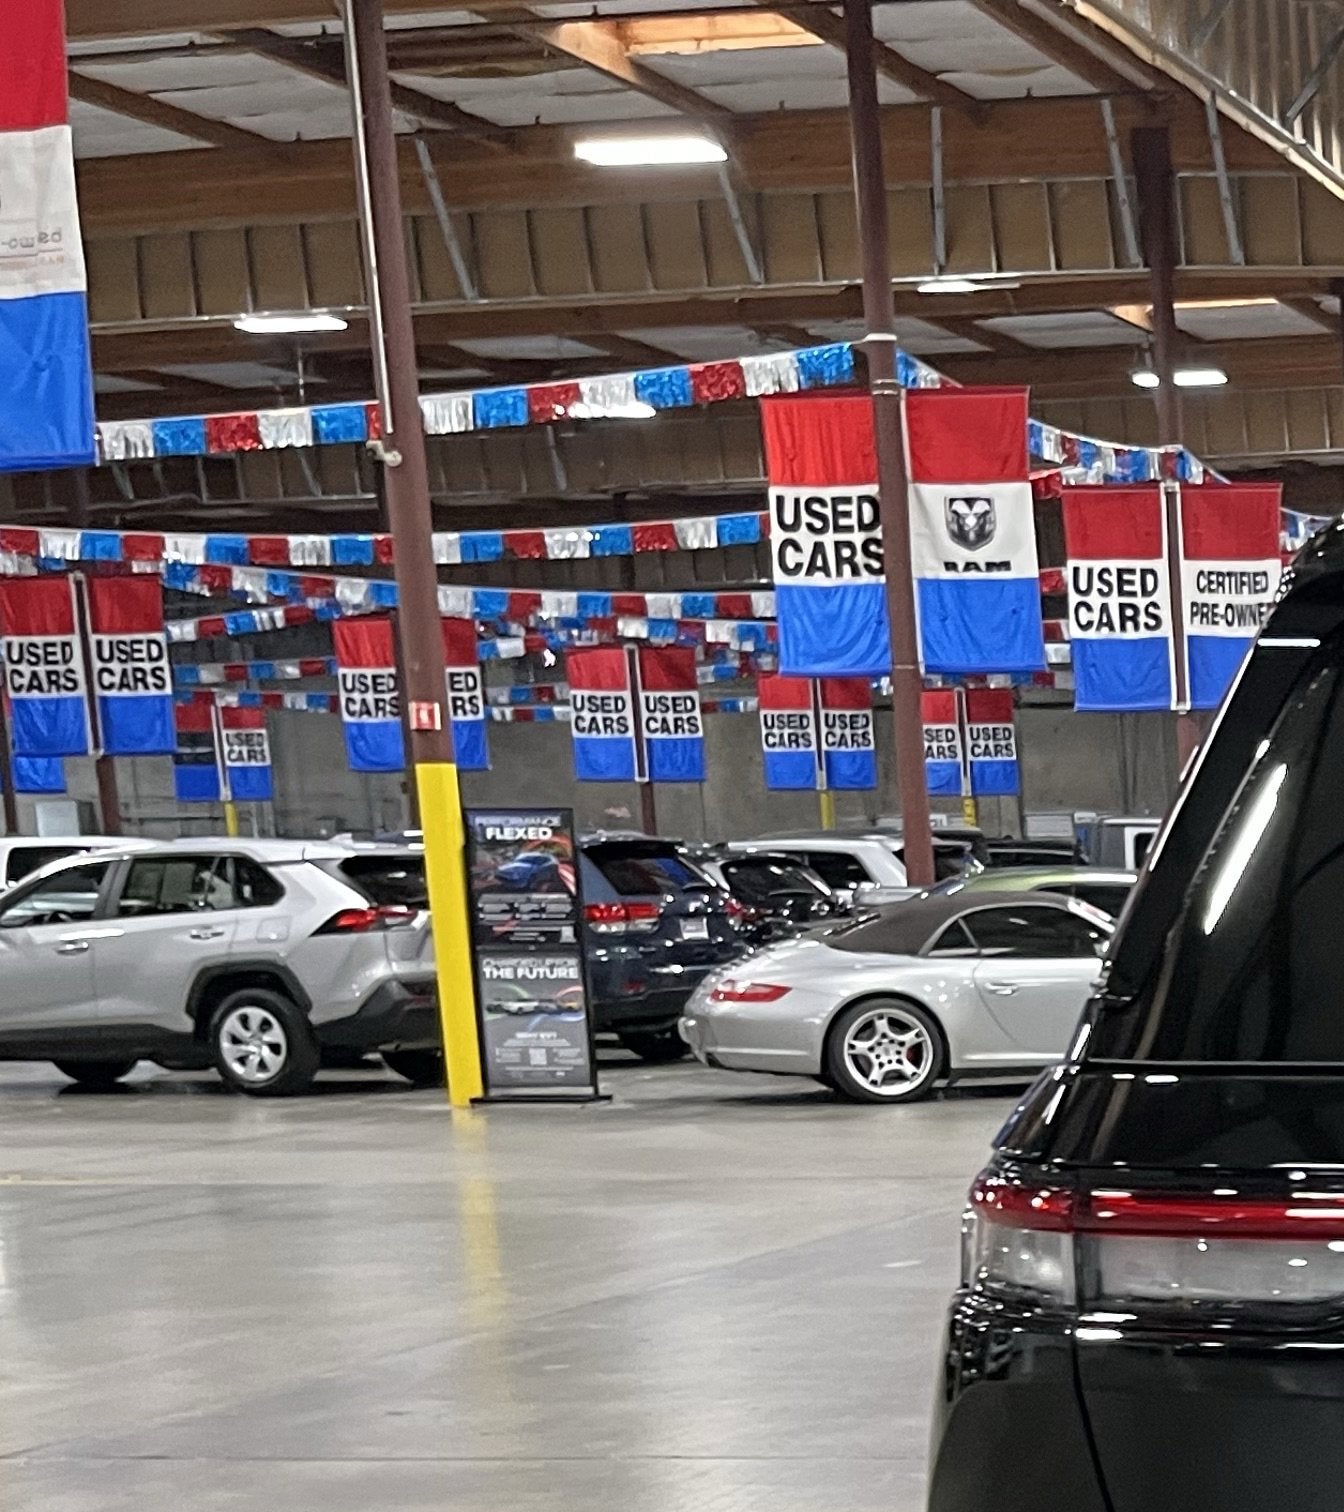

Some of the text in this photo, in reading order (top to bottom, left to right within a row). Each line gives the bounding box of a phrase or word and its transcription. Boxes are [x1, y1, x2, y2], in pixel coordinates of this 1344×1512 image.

[775, 494, 880, 536] USED
[777, 537, 885, 578] CARS
[943, 560, 1012, 573] RAM
[1072, 566, 1159, 598] USED
[1196, 569, 1269, 595] CERTIFIED
[1073, 600, 1162, 633] CARS
[1190, 601, 1268, 627] PRE-OWNE
[6, 640, 74, 667] USED
[96, 638, 164, 664] USED
[9, 667, 79, 693] CARS
[97, 666, 167, 692] CARS
[342, 672, 397, 695] USED
[450, 671, 478, 693] ED
[345, 696, 401, 718] CARS
[452, 695, 481, 717] RS
[572, 694, 627, 714] USED
[645, 694, 697, 714] USED
[574, 714, 630, 735] CARS
[645, 714, 701, 735] CARS
[763, 712, 810, 731] USED
[824, 712, 870, 731] USED
[225, 732, 264, 748] USED
[764, 731, 813, 749] CARS
[824, 731, 872, 749] CARS
[924, 727, 956, 744] SED
[969, 726, 1012, 743] USED
[226, 749, 266, 763] CARS
[925, 744, 958, 760] ARS
[970, 743, 1014, 758] CARS
[485, 826, 554, 841] FLEXED
[482, 967, 579, 979] THE FUTURE
